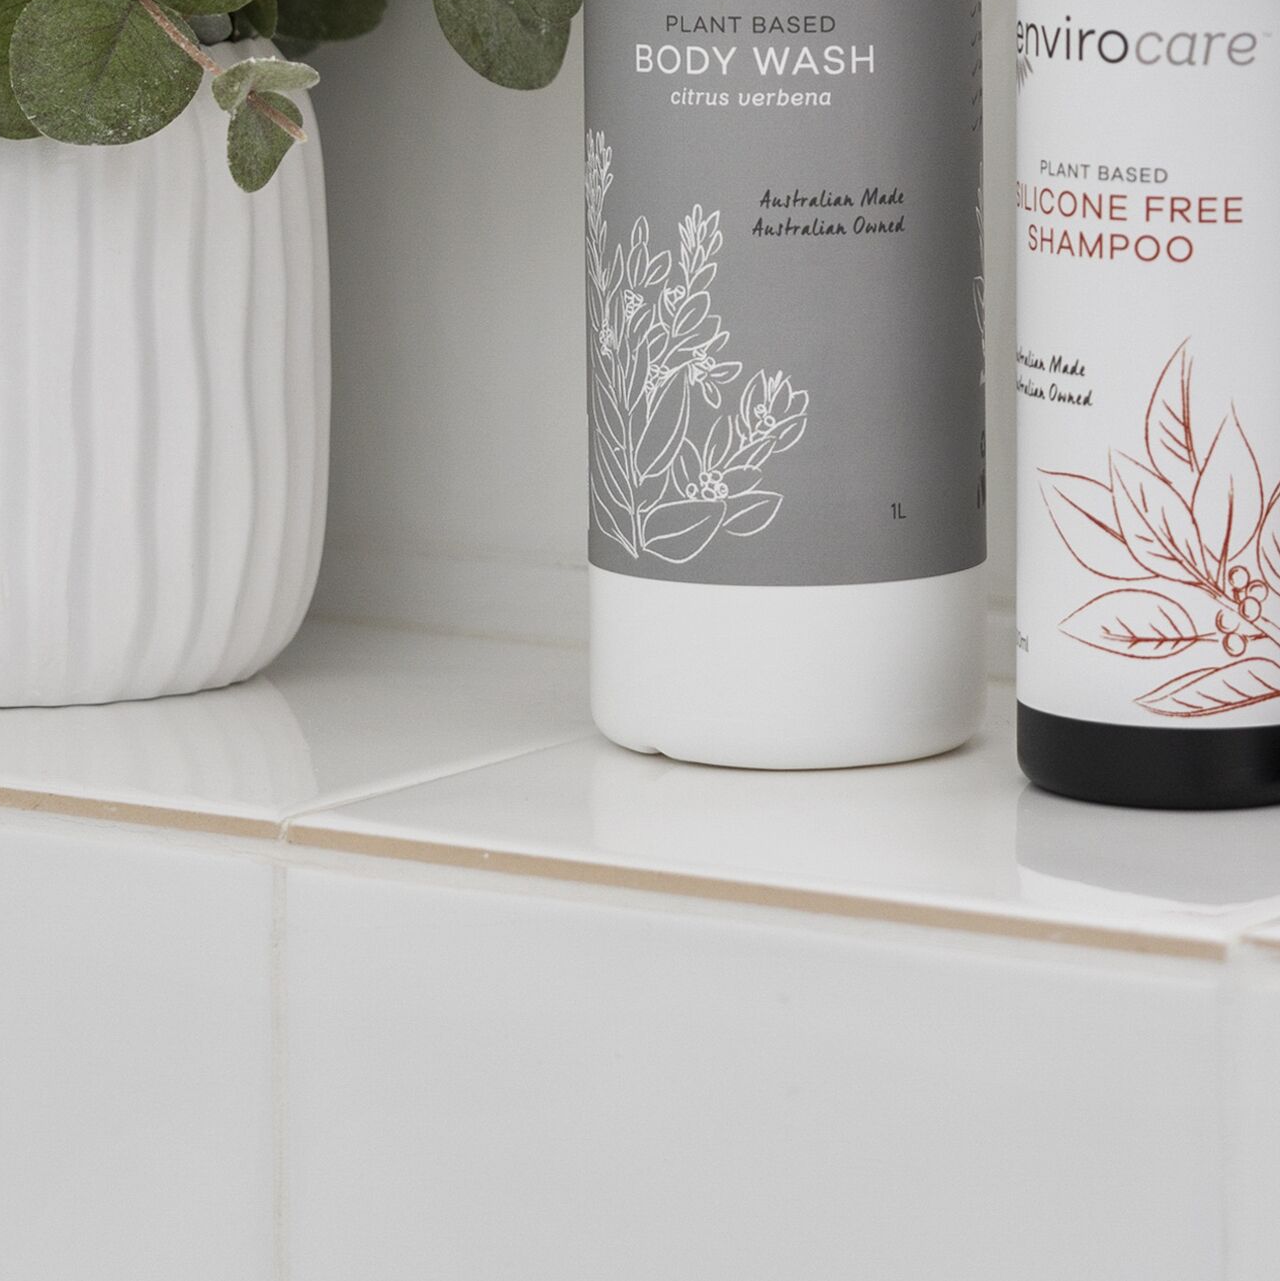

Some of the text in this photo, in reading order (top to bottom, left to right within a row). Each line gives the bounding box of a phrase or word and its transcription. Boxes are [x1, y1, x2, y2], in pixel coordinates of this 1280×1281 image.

[665, 15, 836, 34] PLANT BASED
[1016, 15, 1257, 66] envirocare
[635, 44, 875, 76] BODY WASH
[670, 87, 832, 107] citrus verbena
[1040, 159, 1168, 184] PLANT BASED
[760, 187, 905, 209] Australian Made
[1145, 195, 1244, 224] FREE
[752, 215, 905, 237] Australian Owned
[1028, 224, 1194, 263] SHAMPOO
[1049, 354, 1086, 377] Made
[1049, 382, 1093, 407] Owned
